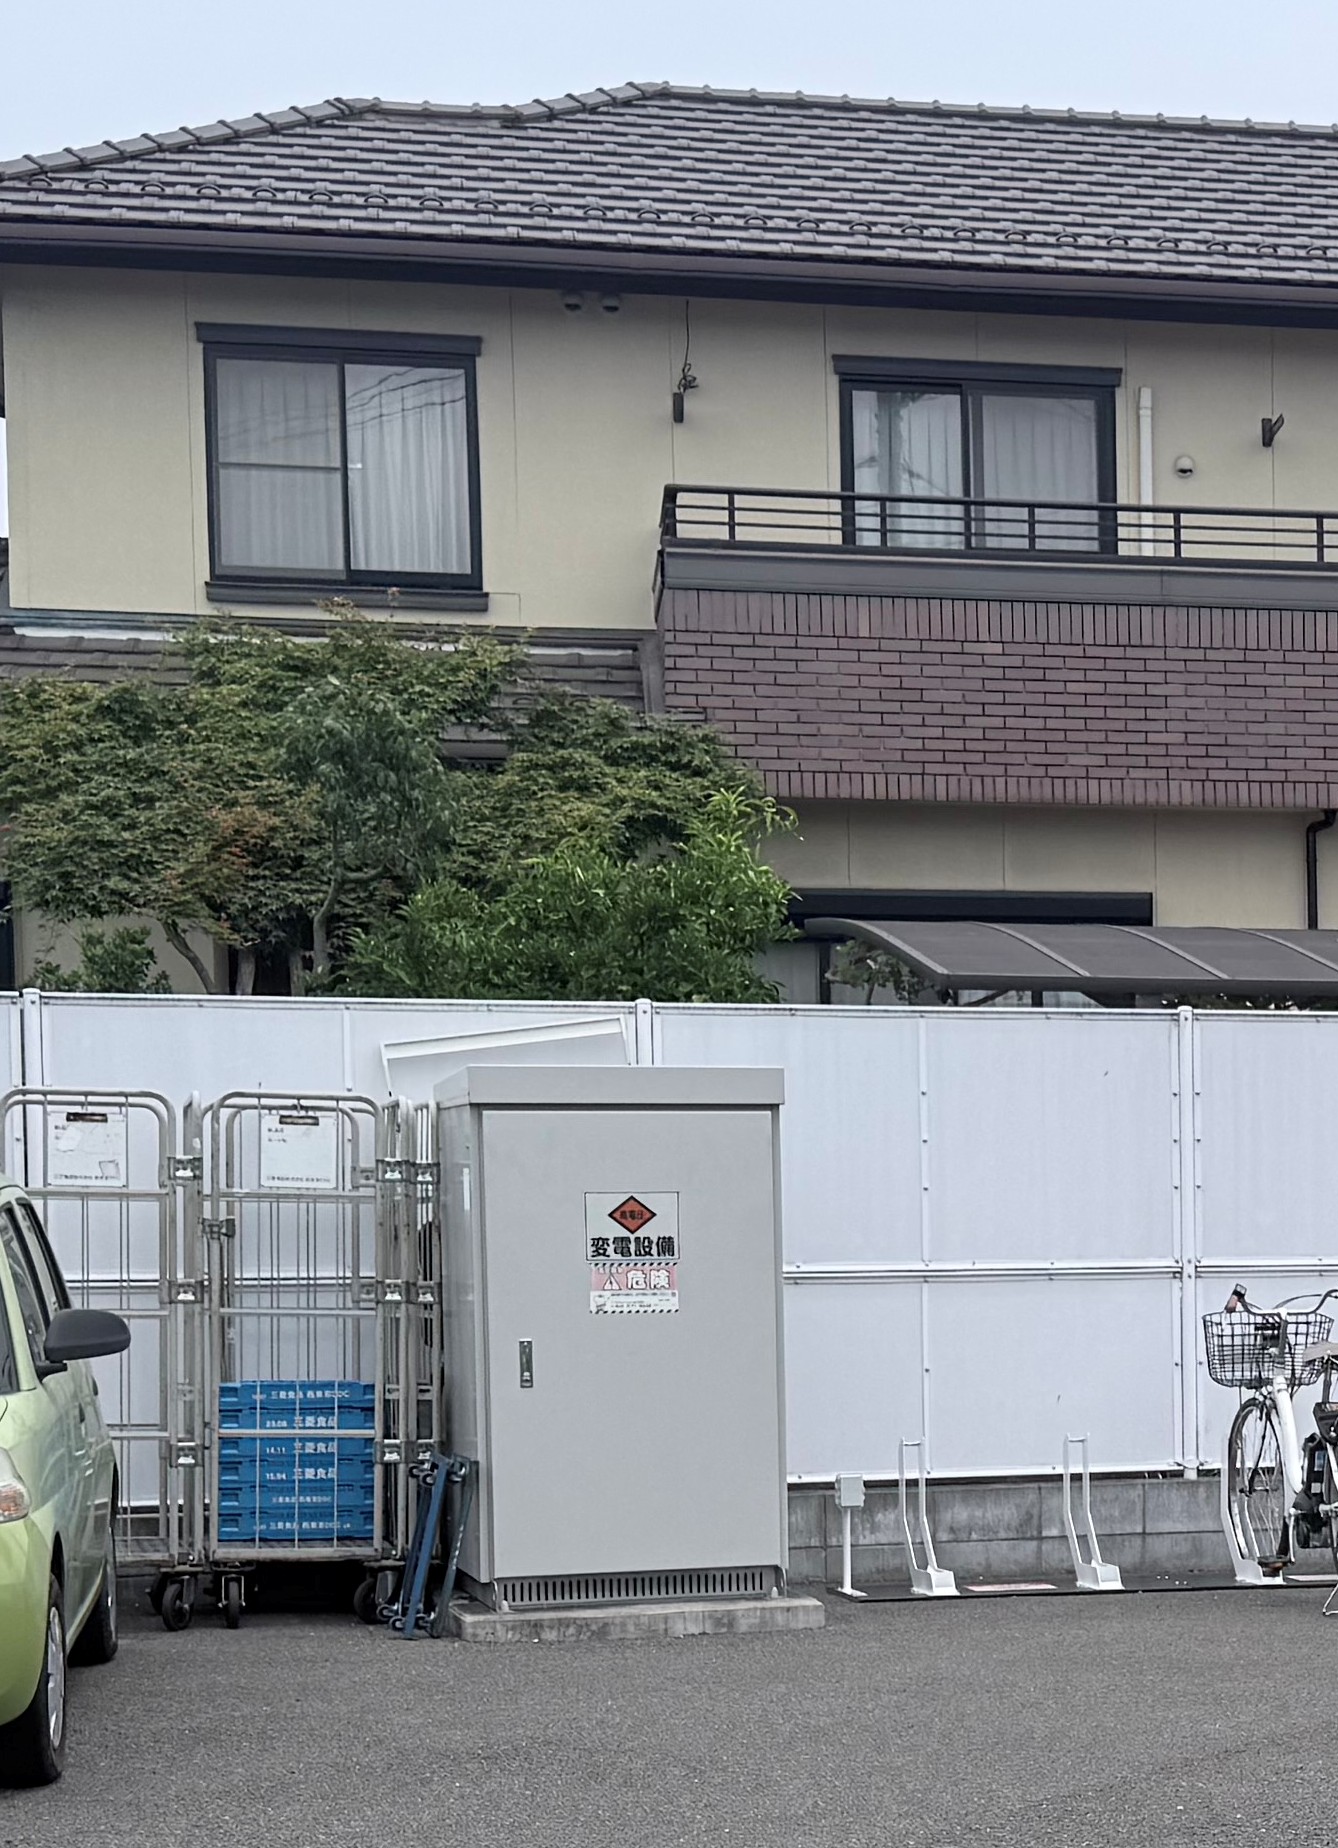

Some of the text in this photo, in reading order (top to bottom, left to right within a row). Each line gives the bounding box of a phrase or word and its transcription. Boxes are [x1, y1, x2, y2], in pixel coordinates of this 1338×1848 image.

[590, 1236, 675, 1258] 変電設備
[626, 1268, 671, 1290] 危険
